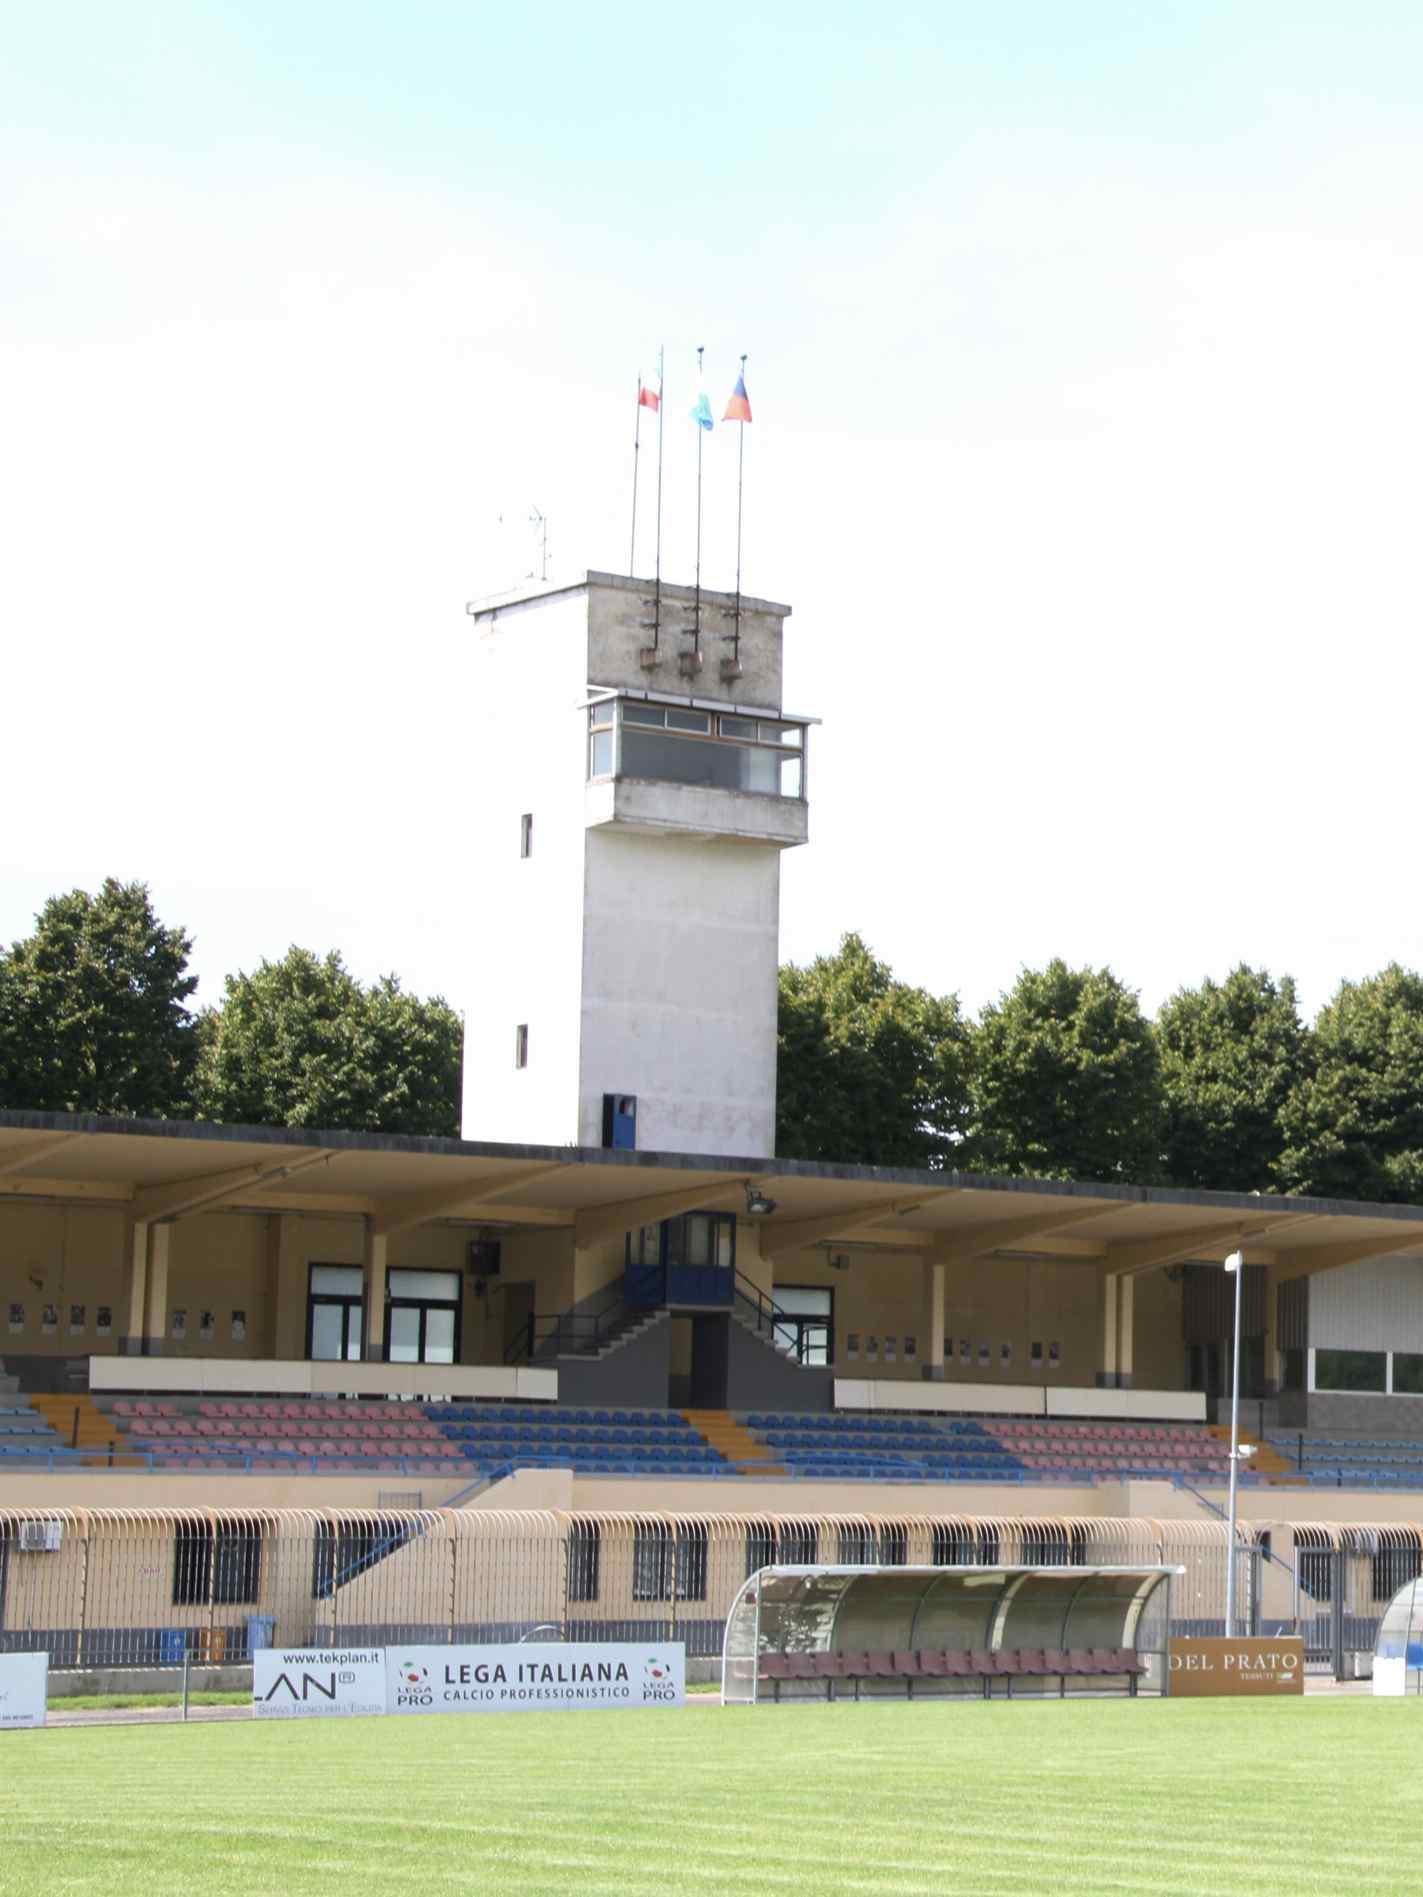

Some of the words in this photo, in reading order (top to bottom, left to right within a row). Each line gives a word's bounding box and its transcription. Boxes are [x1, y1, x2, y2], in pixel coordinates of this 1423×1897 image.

[282, 1652, 379, 1666] www.tekplan.it
[1223, 1652, 1298, 1670] PRATO
[445, 1663, 507, 1684] LEGA
[519, 1662, 629, 1683] ITALIANA
[397, 1694, 433, 1706] PRO
[443, 1689, 494, 1701] CALCIO
[500, 1686, 630, 1700] PROFESSIONISTICO
[643, 1690, 675, 1701] PRO
